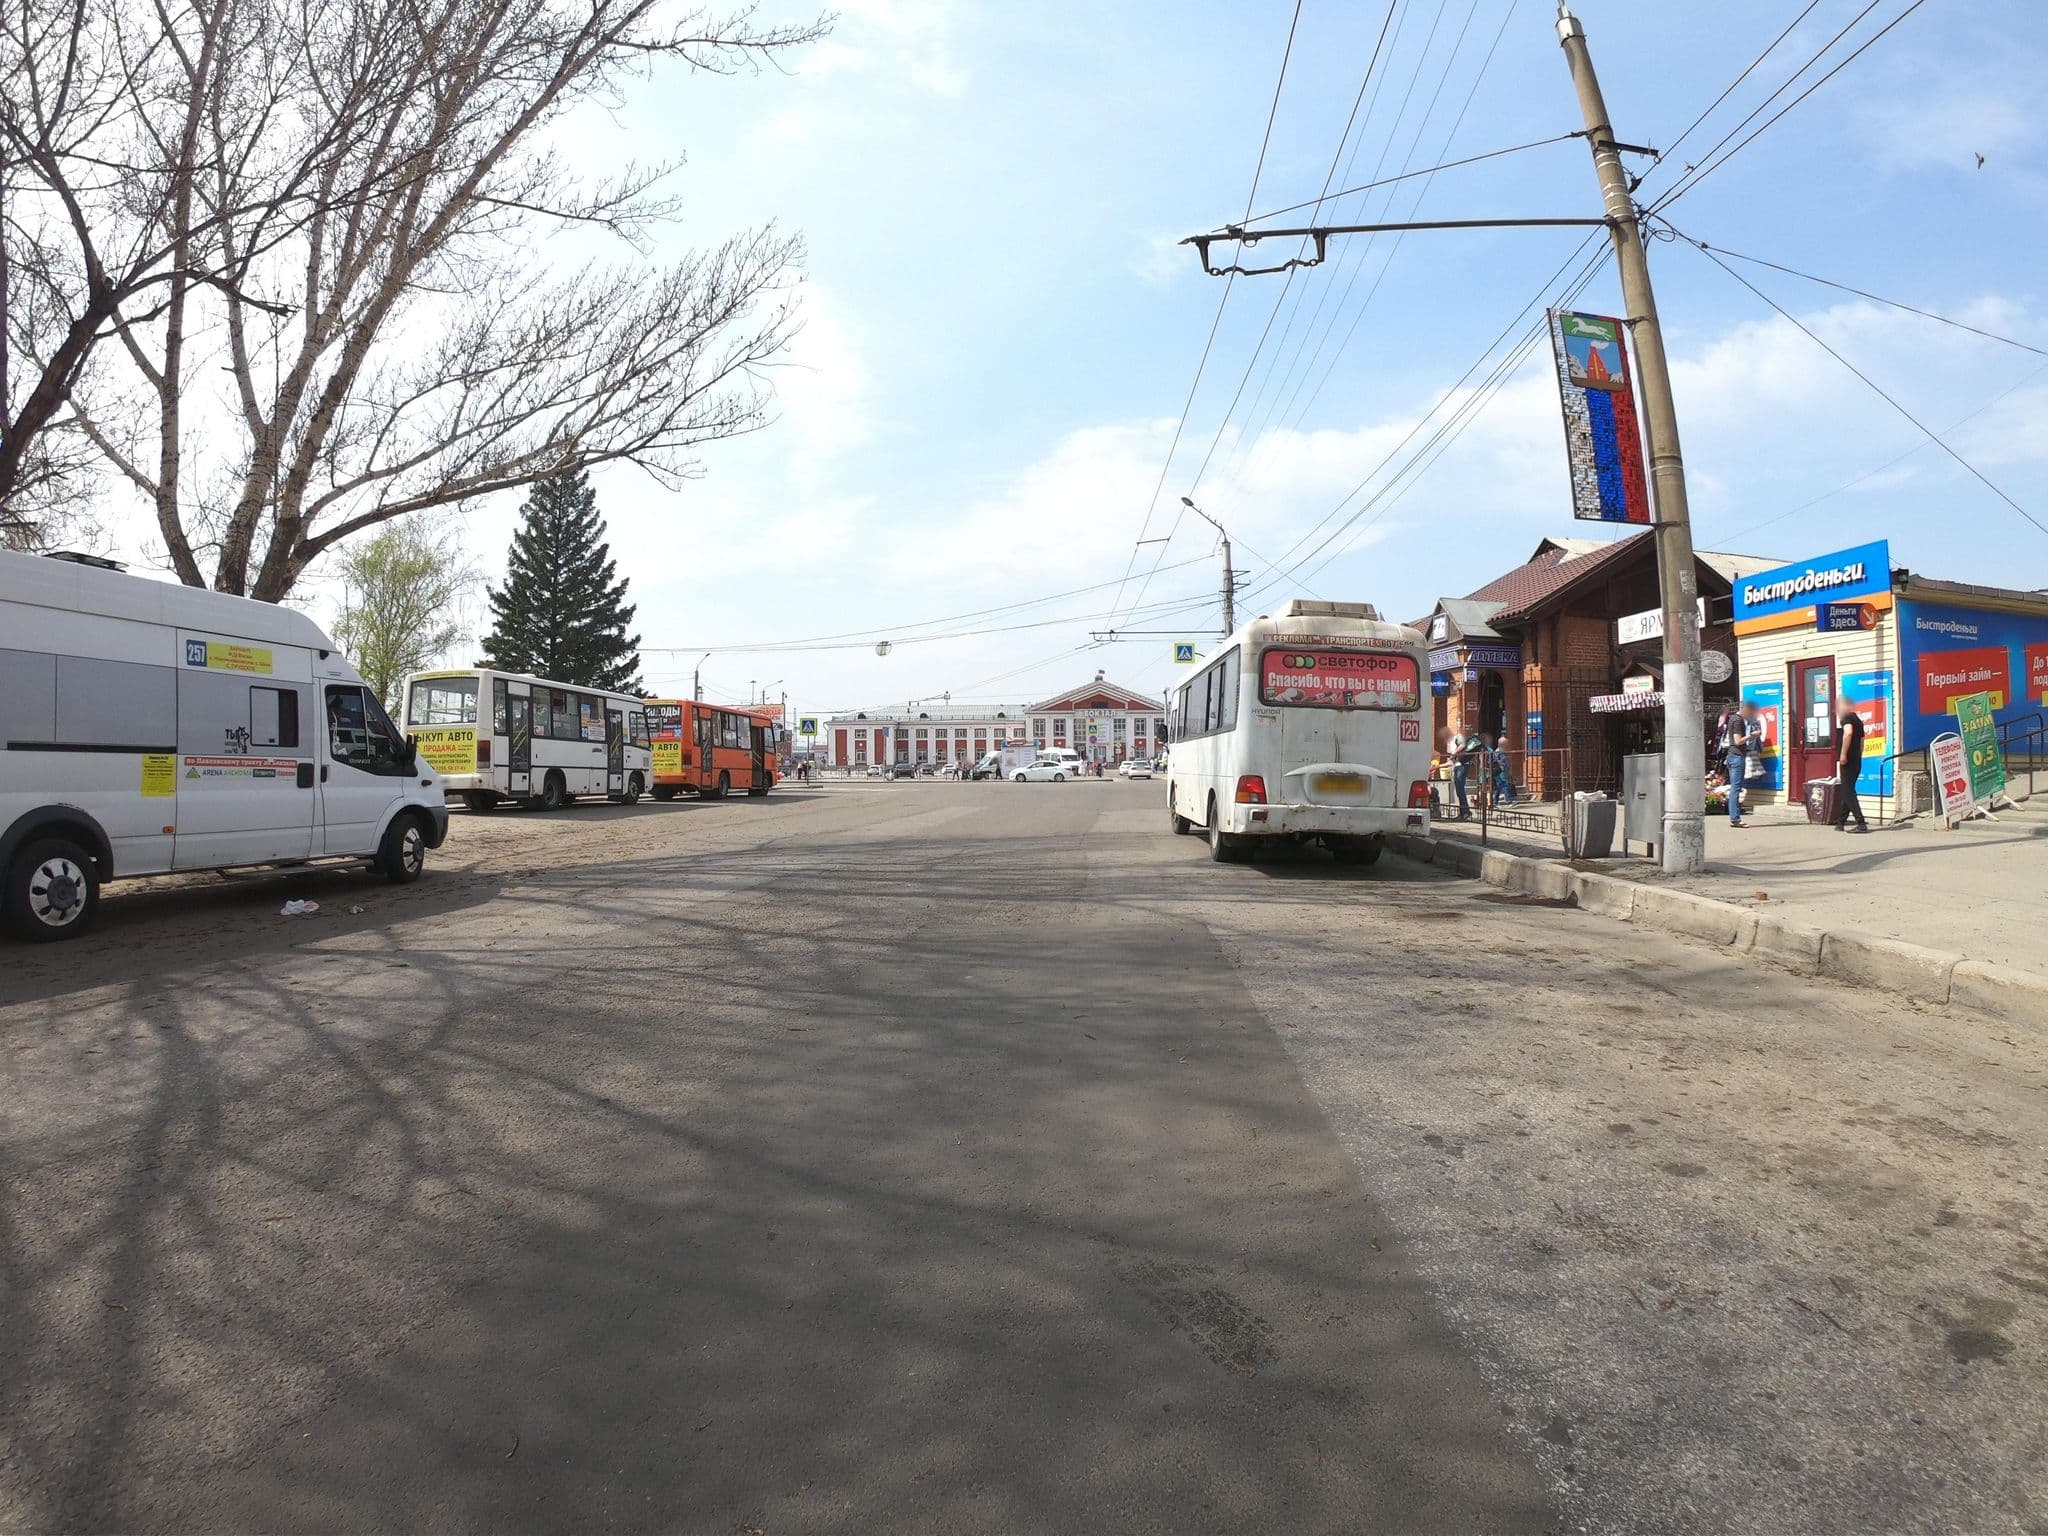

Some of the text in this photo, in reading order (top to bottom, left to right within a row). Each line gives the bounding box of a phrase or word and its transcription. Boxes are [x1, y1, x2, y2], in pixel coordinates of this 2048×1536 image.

[1744, 562, 1863, 605] Быстроденьги
[1829, 606, 1857, 618] Деньги
[1830, 618, 1857, 628] здесь
[1916, 618, 1978, 634] Быстроденьги
[187, 643, 206, 662] 257
[1318, 656, 1398, 672] светофор
[1268, 672, 1411, 692] Спасибо, что вы с нами!
[1926, 669, 1966, 688] Первый
[1968, 667, 1991, 681] займ
[415, 731, 473, 742] ЫКУП АВТО
[1401, 722, 1419, 740] 120
[424, 744, 457, 753] ПРОДАЖА
[657, 743, 679, 751] АВТО
